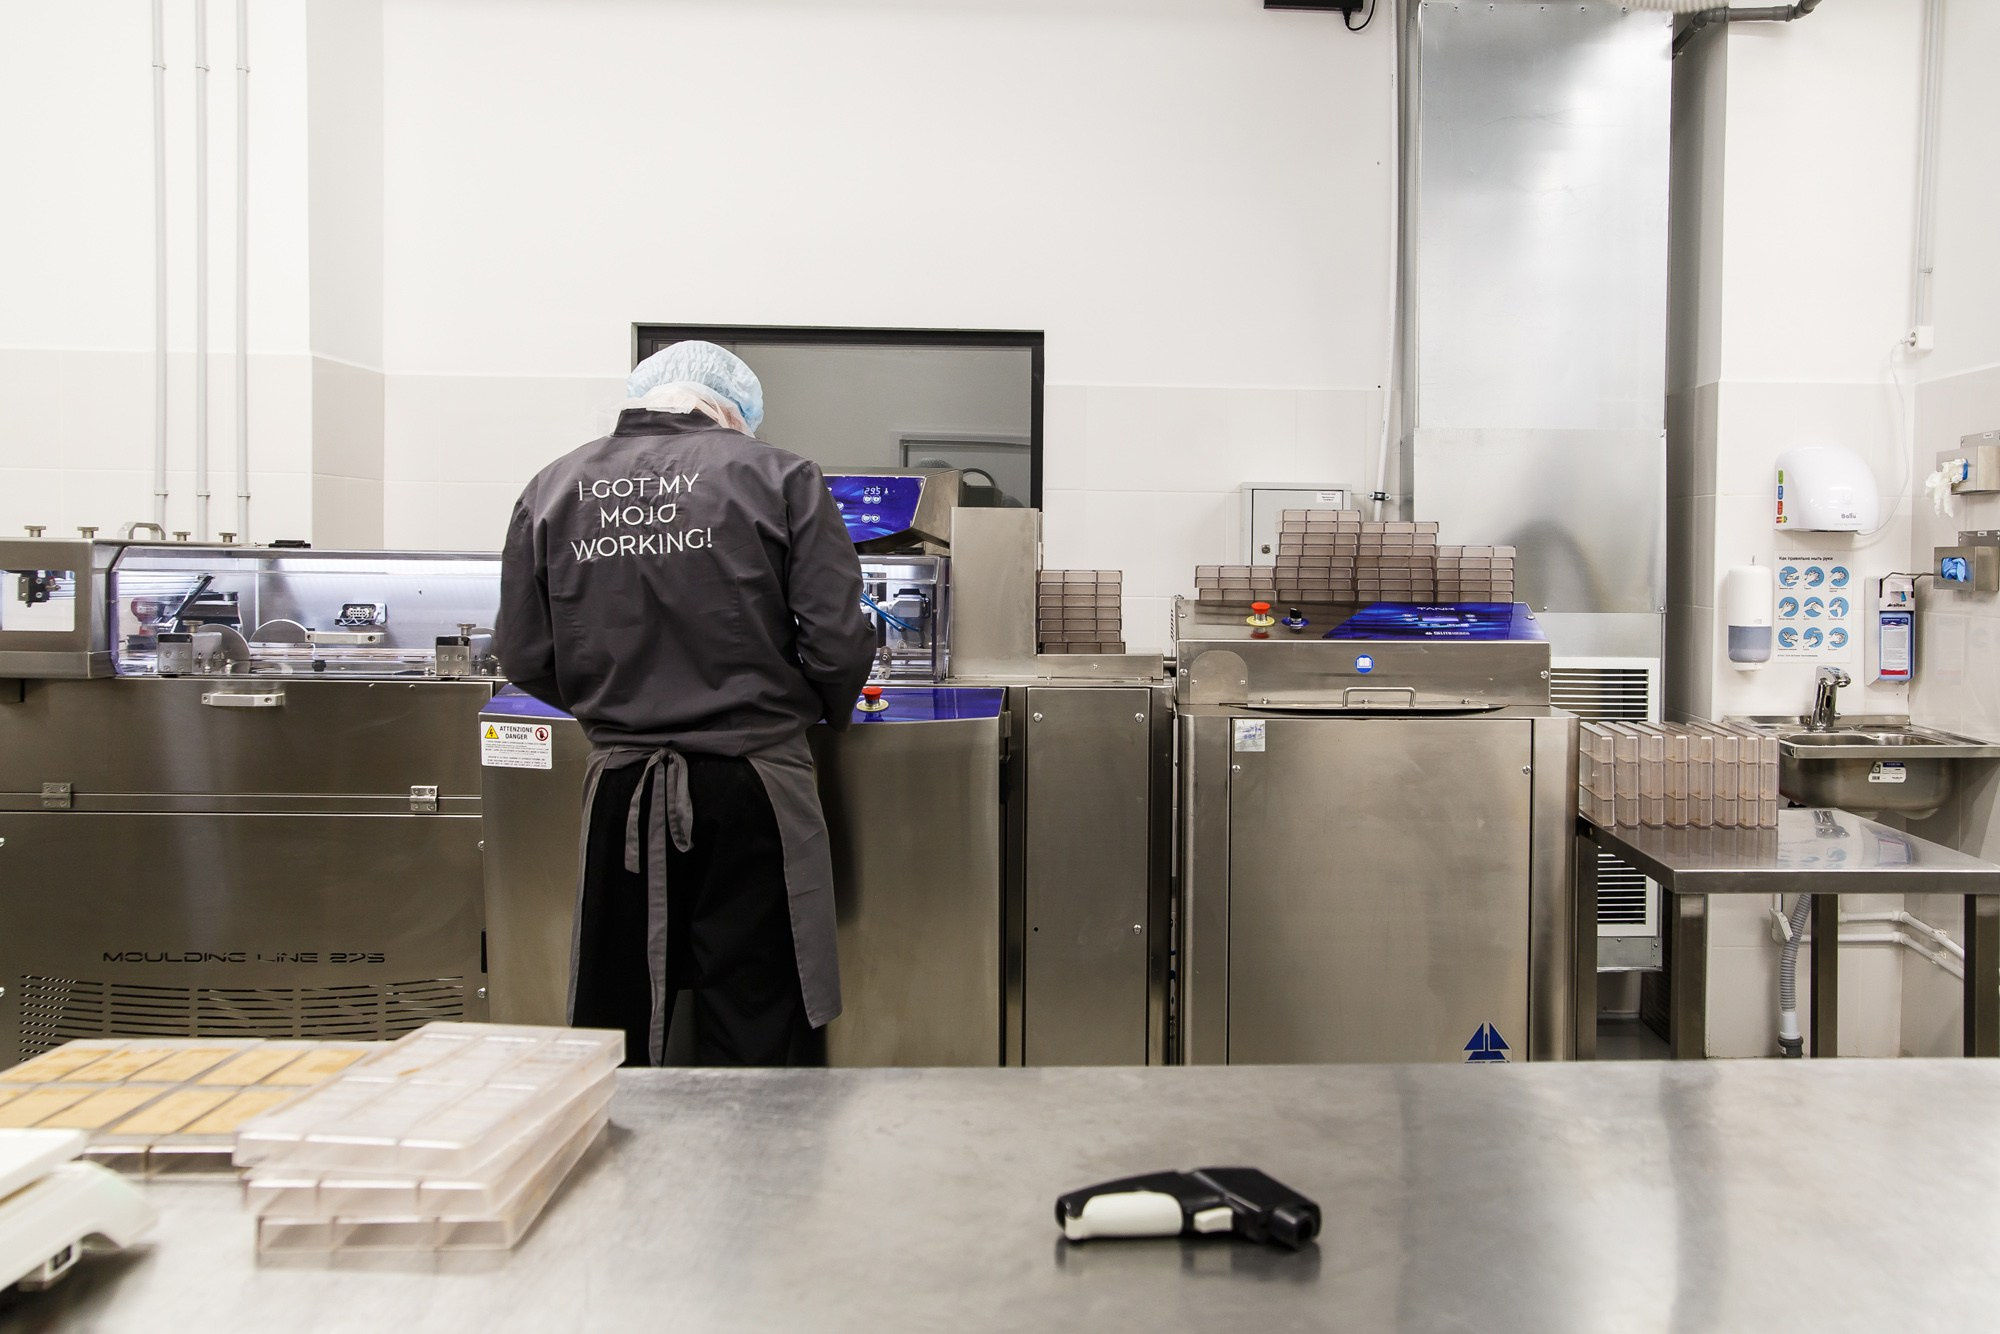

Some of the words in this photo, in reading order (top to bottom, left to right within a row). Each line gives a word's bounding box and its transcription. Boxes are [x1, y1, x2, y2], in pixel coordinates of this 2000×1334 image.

[578, 480, 583, 501] I
[592, 477, 651, 499] GOT
[659, 473, 699, 495] MY
[600, 504, 676, 528] MOJO
[571, 527, 712, 560] WORKING!
[102, 951, 246, 963] MOULDING
[257, 951, 319, 963] LINE
[329, 951, 386, 963] 275
